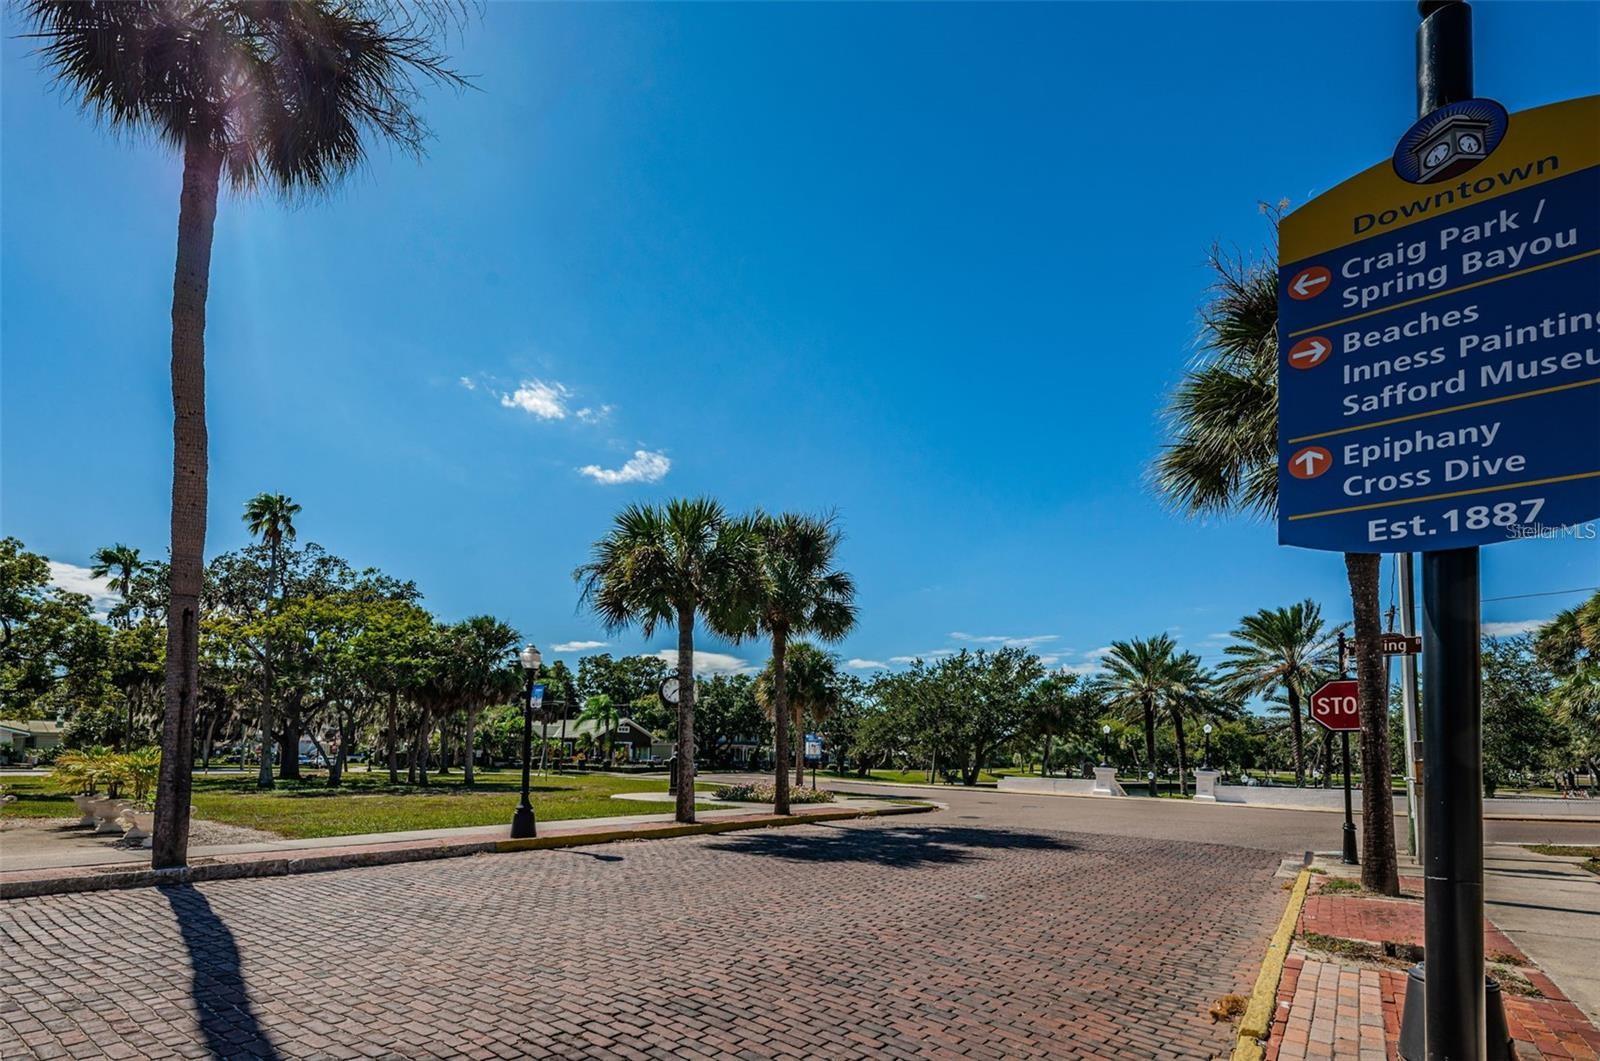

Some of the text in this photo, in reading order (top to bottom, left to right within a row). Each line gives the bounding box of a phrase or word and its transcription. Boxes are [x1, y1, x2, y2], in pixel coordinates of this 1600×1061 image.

[1353, 154, 1560, 235] Downtown
[1341, 199, 1546, 278] Craig Park /
[1342, 228, 1577, 309] Spring Bayou
[1343, 305, 1480, 354] Beaches
[1343, 311, 1600, 385] Inness Paintin
[1343, 348, 1600, 416] Safford Museu
[1343, 422, 1501, 468] Epiphany
[1343, 455, 1526, 497] Cross Dive
[1383, 640, 1407, 654] ing
[1316, 696, 1358, 715] STO
